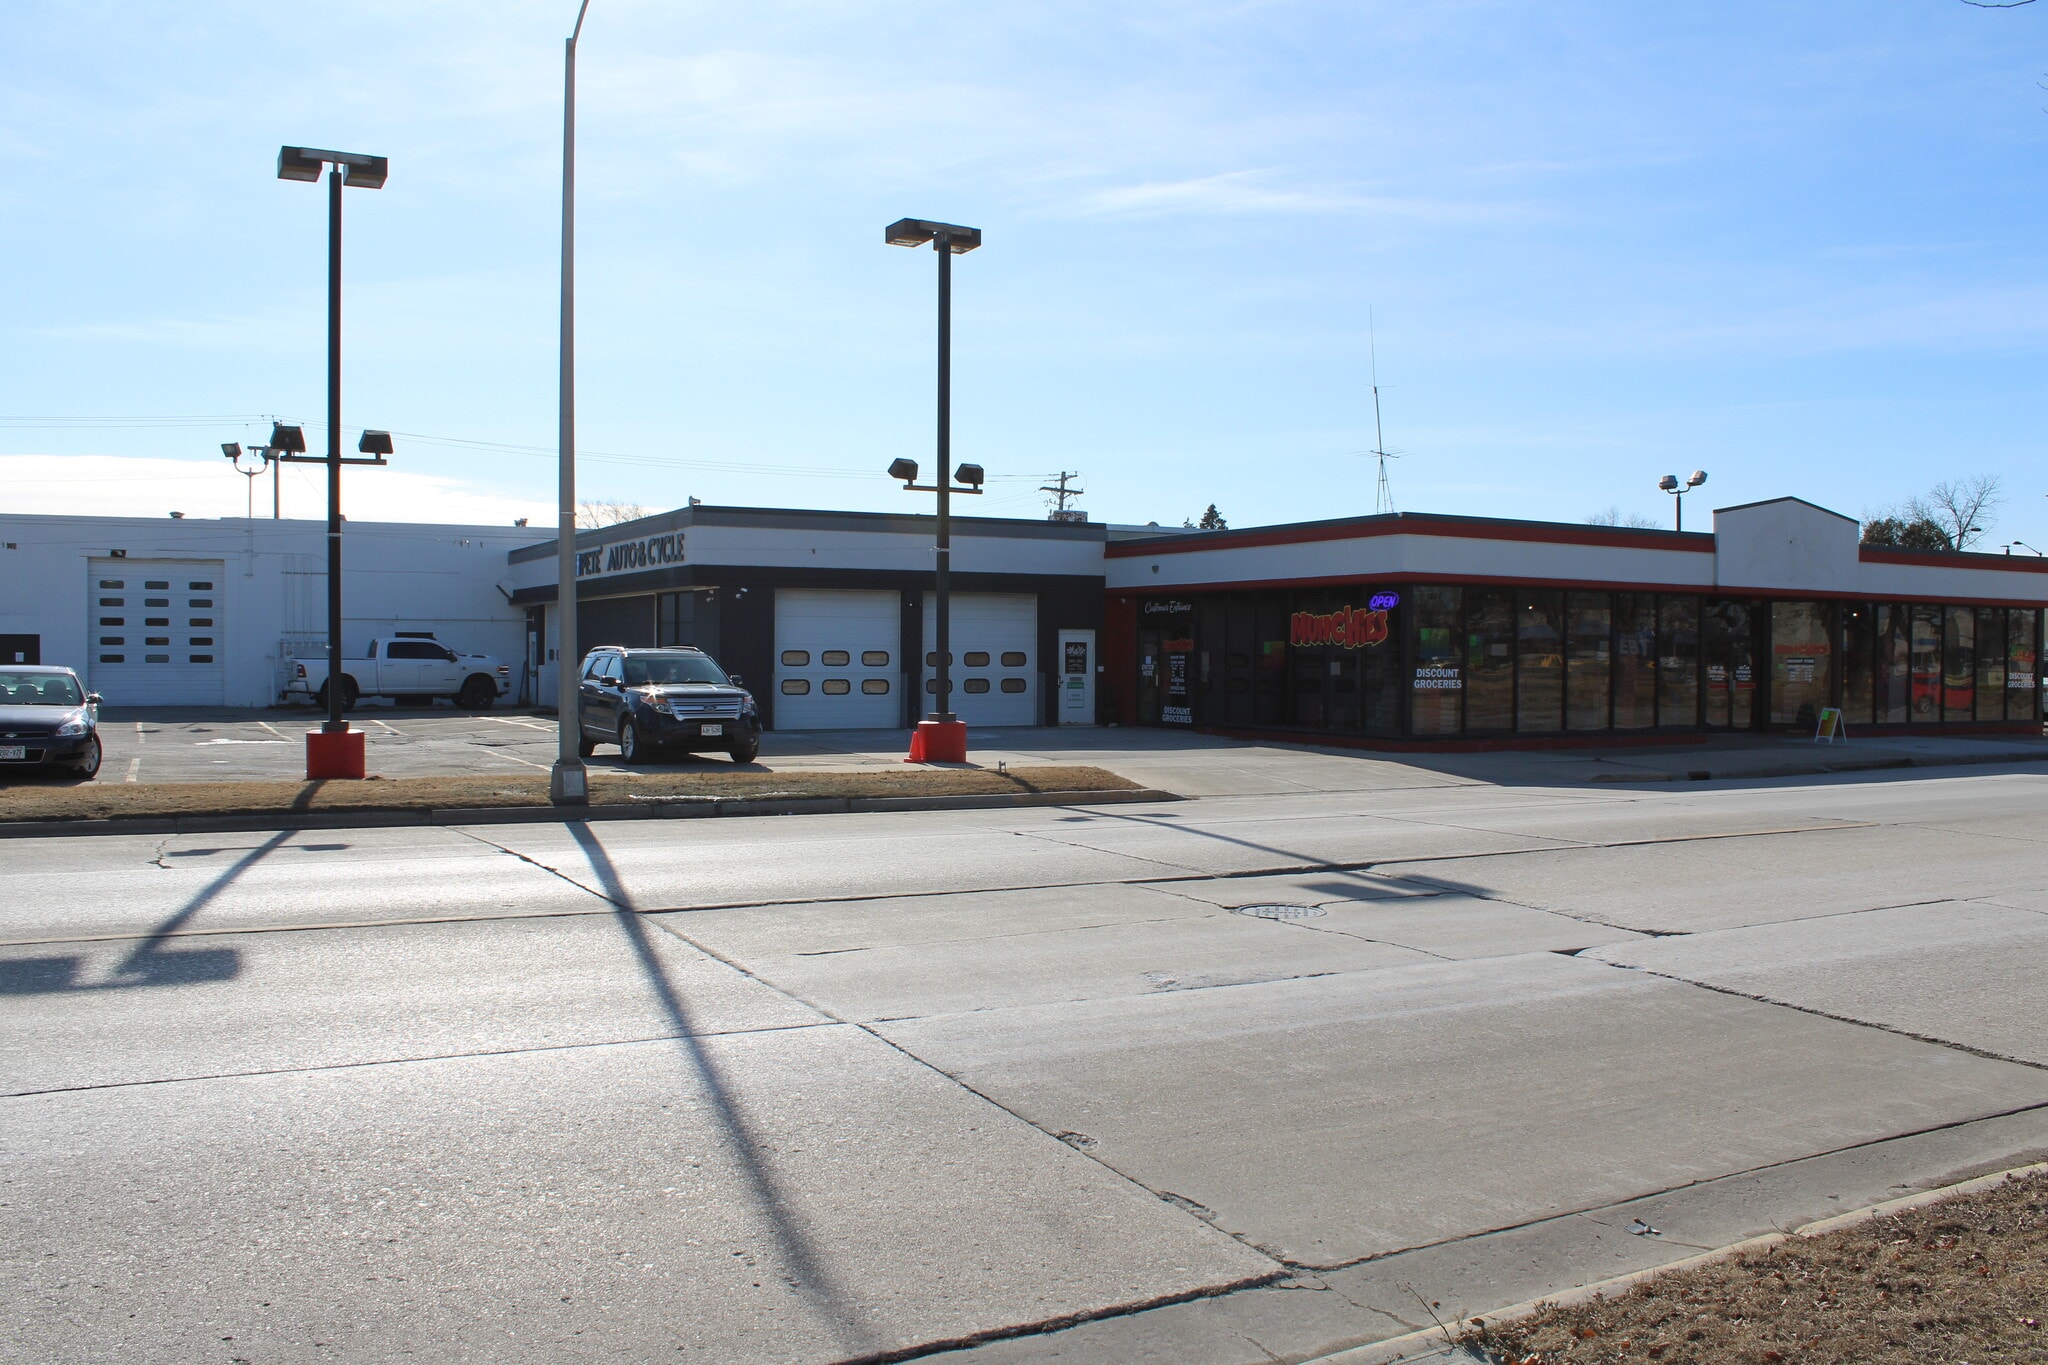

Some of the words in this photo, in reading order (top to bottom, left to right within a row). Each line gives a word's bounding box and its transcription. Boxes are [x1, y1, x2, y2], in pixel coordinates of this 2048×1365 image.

[1371, 595, 1396, 608] OPEN
[1416, 668, 1459, 678] DISCOUNT
[2009, 672, 2033, 680] DISCOUNT
[1413, 679, 1463, 689] GROCERIES
[1163, 706, 1191, 716] DISCOUNT
[1162, 713, 1193, 724] GROCERIES
